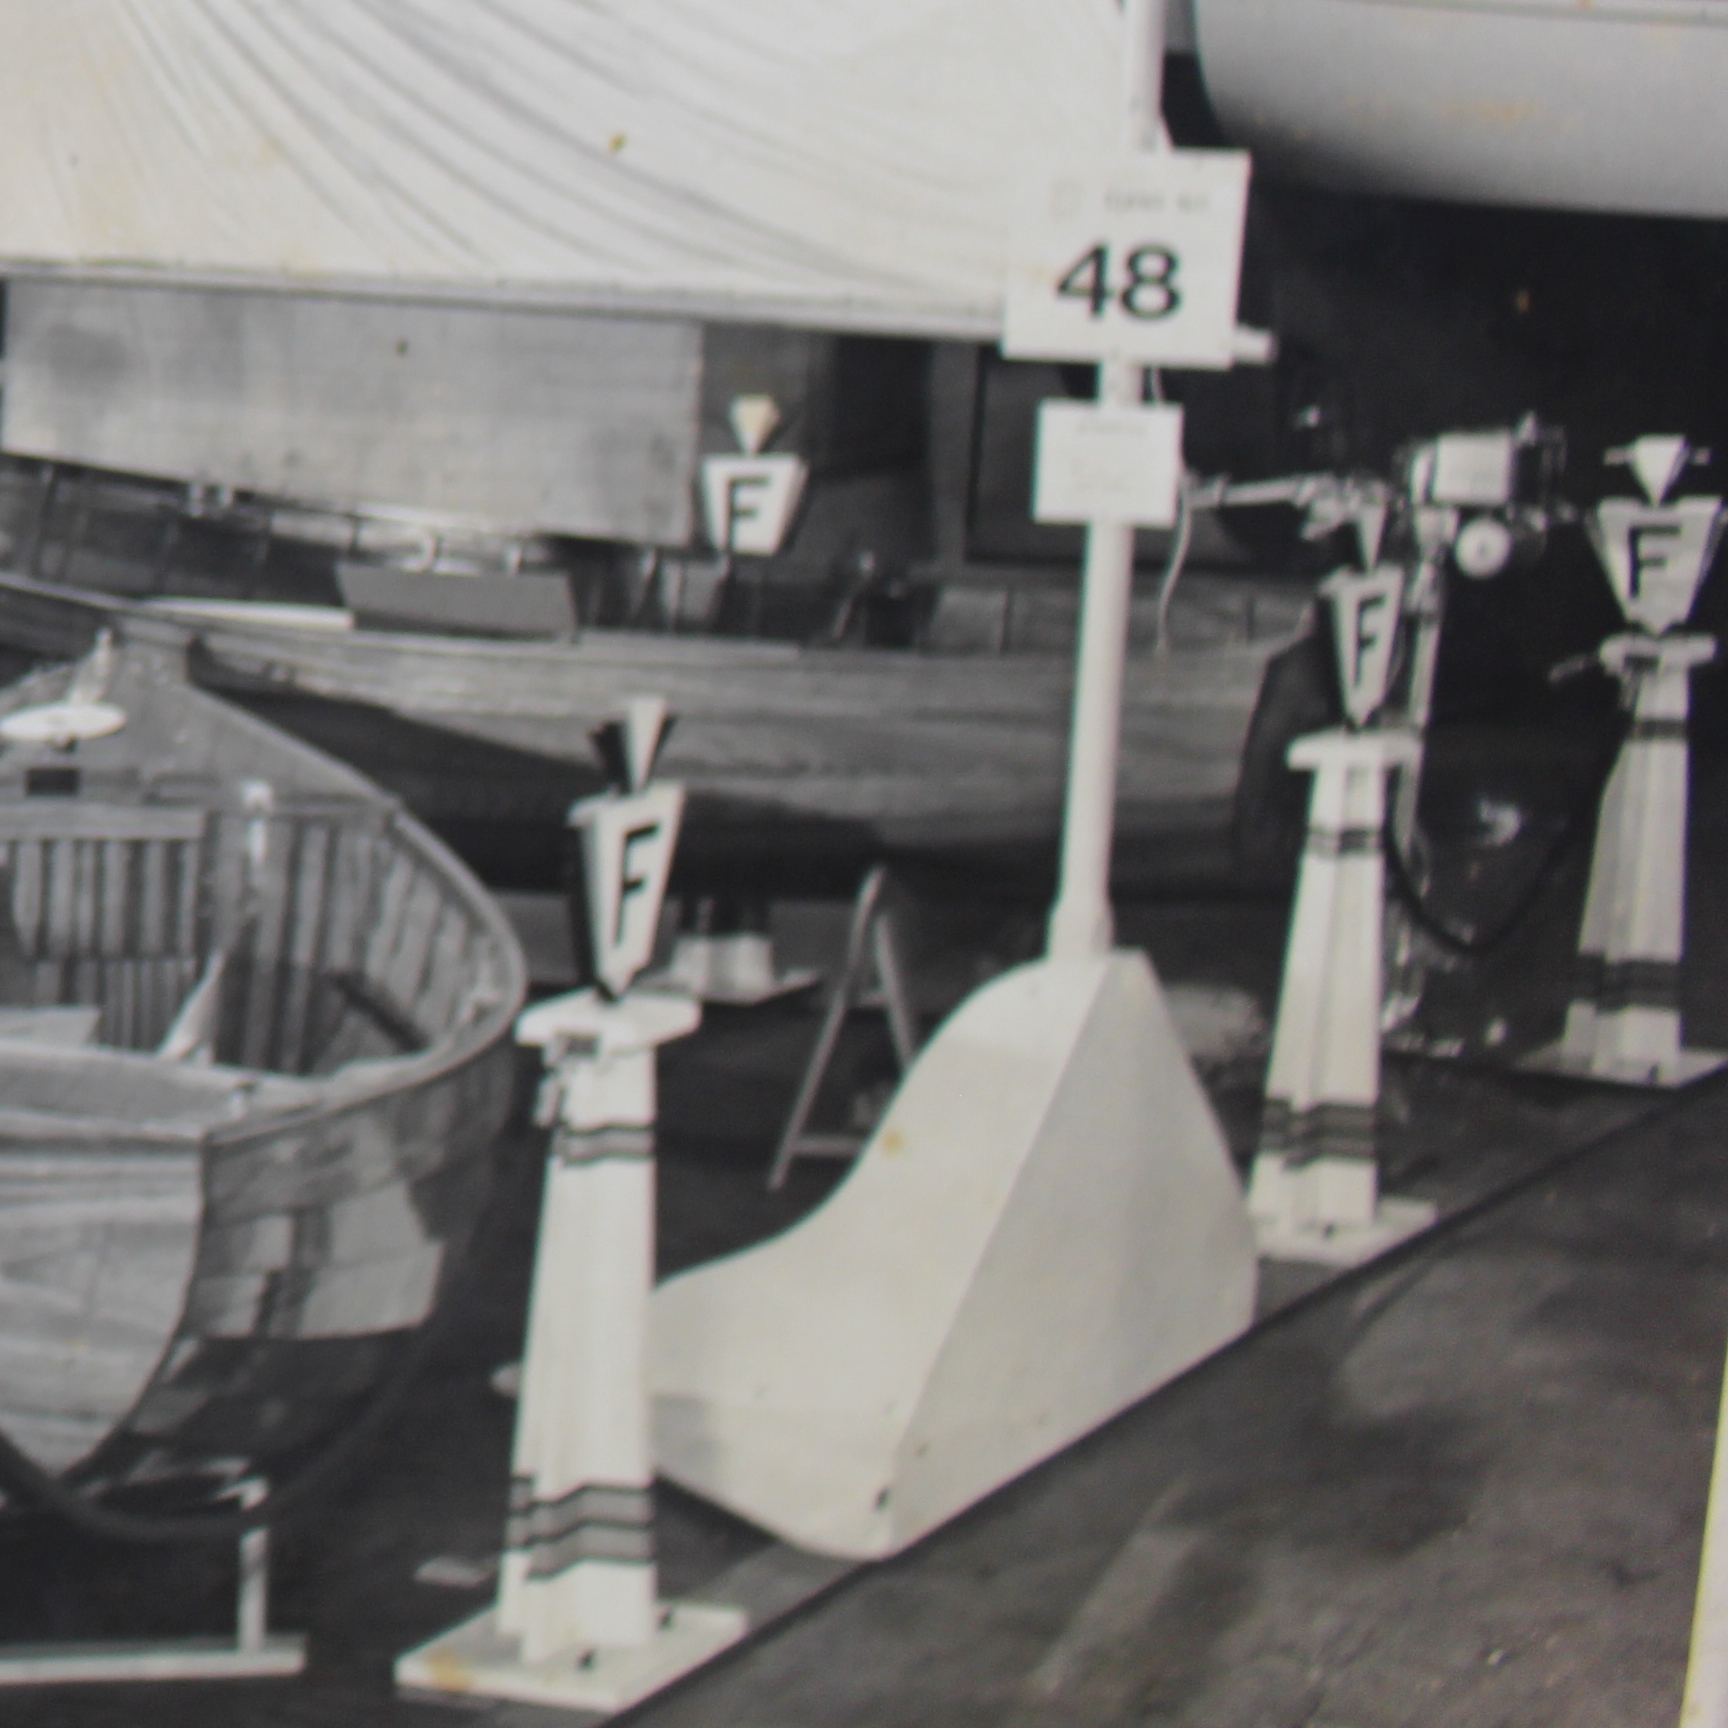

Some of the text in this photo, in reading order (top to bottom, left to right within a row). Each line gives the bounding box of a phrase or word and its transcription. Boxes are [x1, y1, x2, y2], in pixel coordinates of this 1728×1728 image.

[1055, 243, 1183, 322] 48
[727, 475, 773, 557] F
[1626, 523, 1682, 598] F
[1352, 593, 1388, 688] F
[613, 821, 663, 948] F
